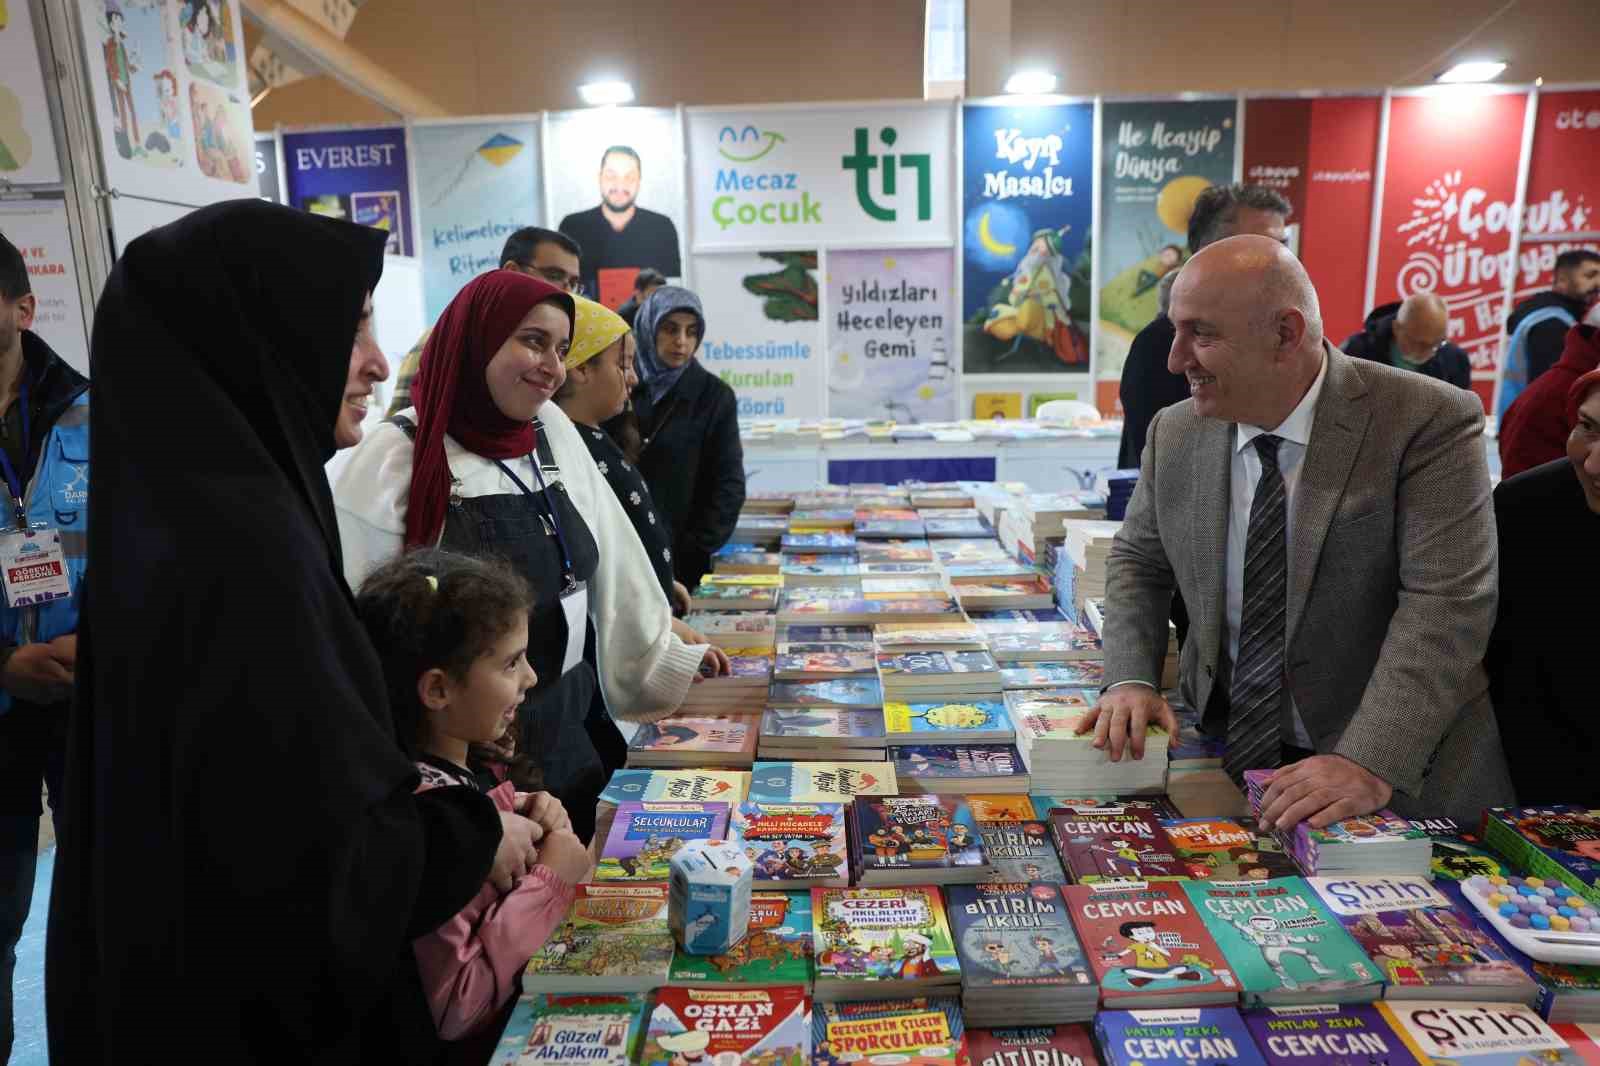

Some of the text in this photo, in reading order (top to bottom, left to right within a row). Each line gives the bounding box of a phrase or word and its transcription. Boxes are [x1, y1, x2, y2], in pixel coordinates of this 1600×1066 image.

[297, 144, 395, 170] EVEREST
[715, 169, 799, 191] Mecaz
[983, 168, 1073, 200] Masalcı
[712, 191, 823, 230] Çocuk
[837, 308, 943, 338] Heceleyen
[703, 341, 812, 361] Tebessümle
[864, 340, 916, 358] Gemi
[1063, 822, 1153, 834] CEMCAN
[1204, 895, 1309, 914] CEMCAN
[1325, 880, 1432, 908] Şirin
[1083, 899, 1187, 919] CEMCAN
[684, 1002, 775, 1018] OSMAN
[554, 1029, 603, 1044] Güzel
[1411, 1008, 1542, 1047] Şirin
[831, 1029, 943, 1053] SPORCULARI
[1267, 1032, 1389, 1057] CEMCAN
